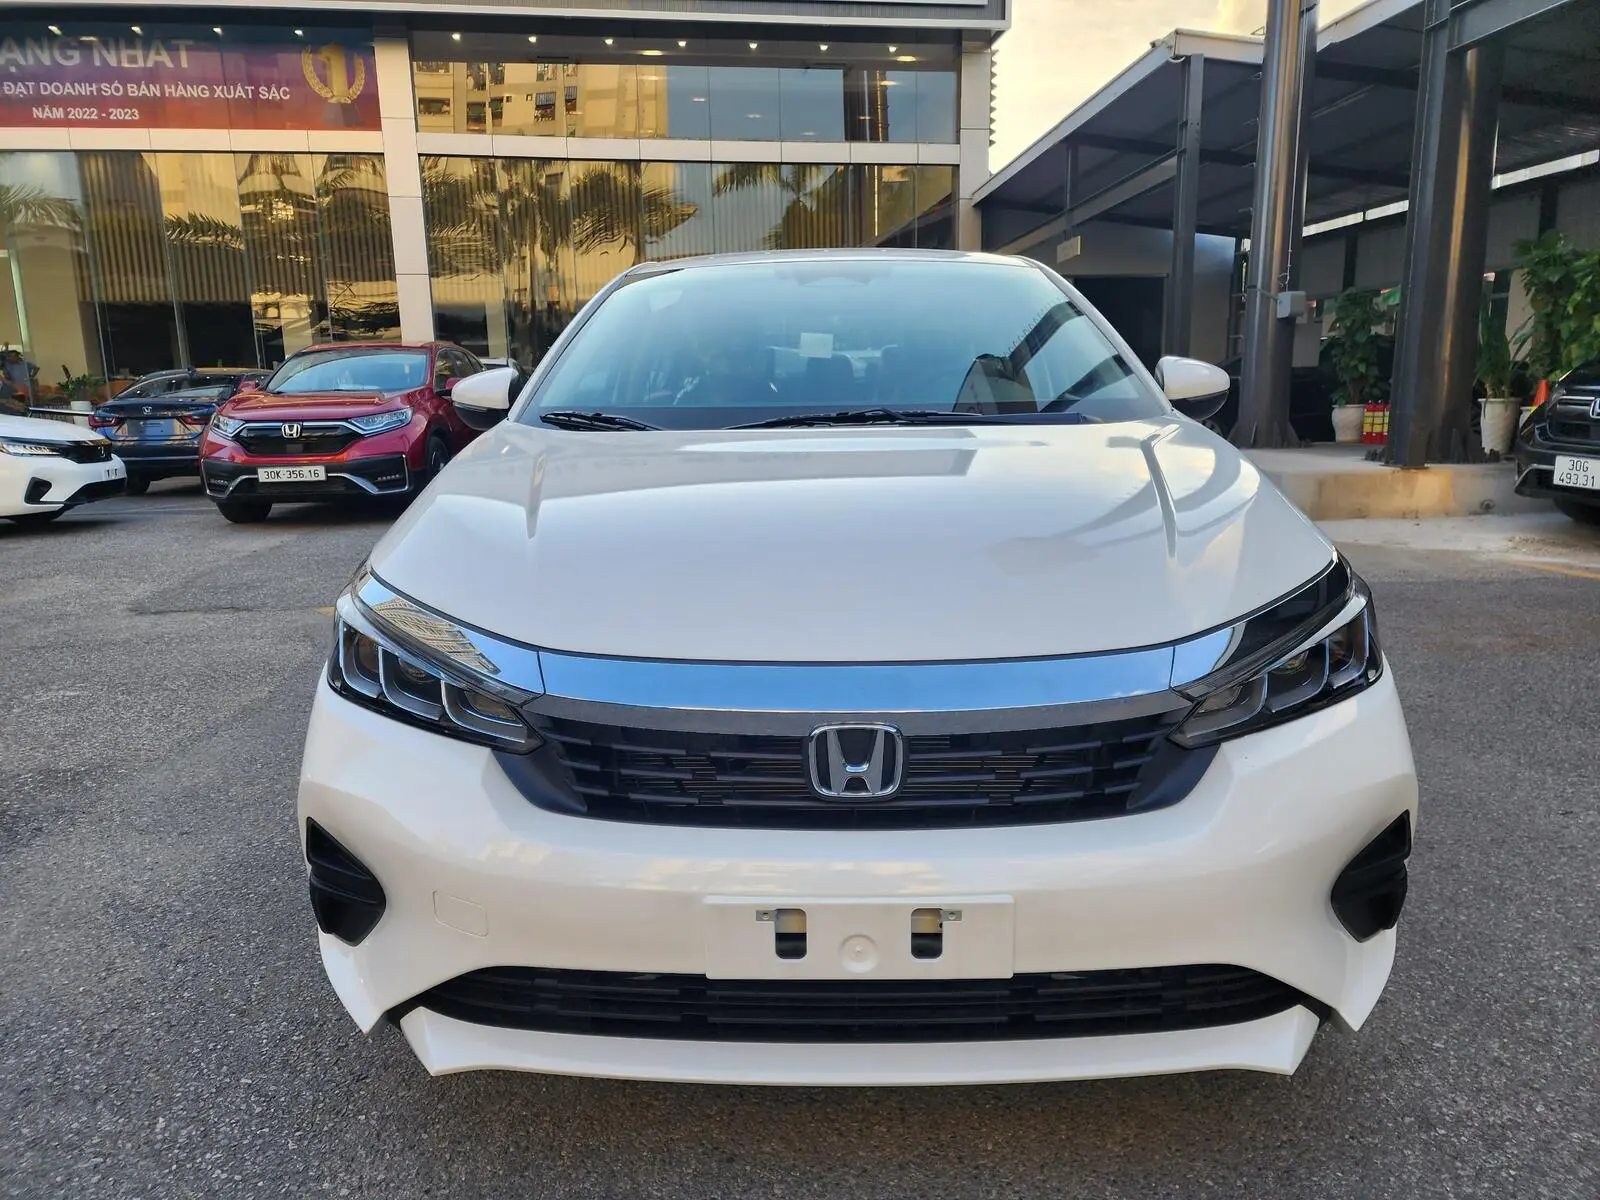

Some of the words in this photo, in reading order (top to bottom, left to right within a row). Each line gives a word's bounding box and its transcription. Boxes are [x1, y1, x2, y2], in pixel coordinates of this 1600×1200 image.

[40, 82, 97, 96] DOANH
[127, 80, 161, 97] BÁN
[164, 82, 209, 98] HÀNG
[68, 107, 98, 120] 2022
[109, 108, 140, 120] 2023
[1568, 459, 1589, 473] 30G
[1559, 472, 1595, 487] 493.31
